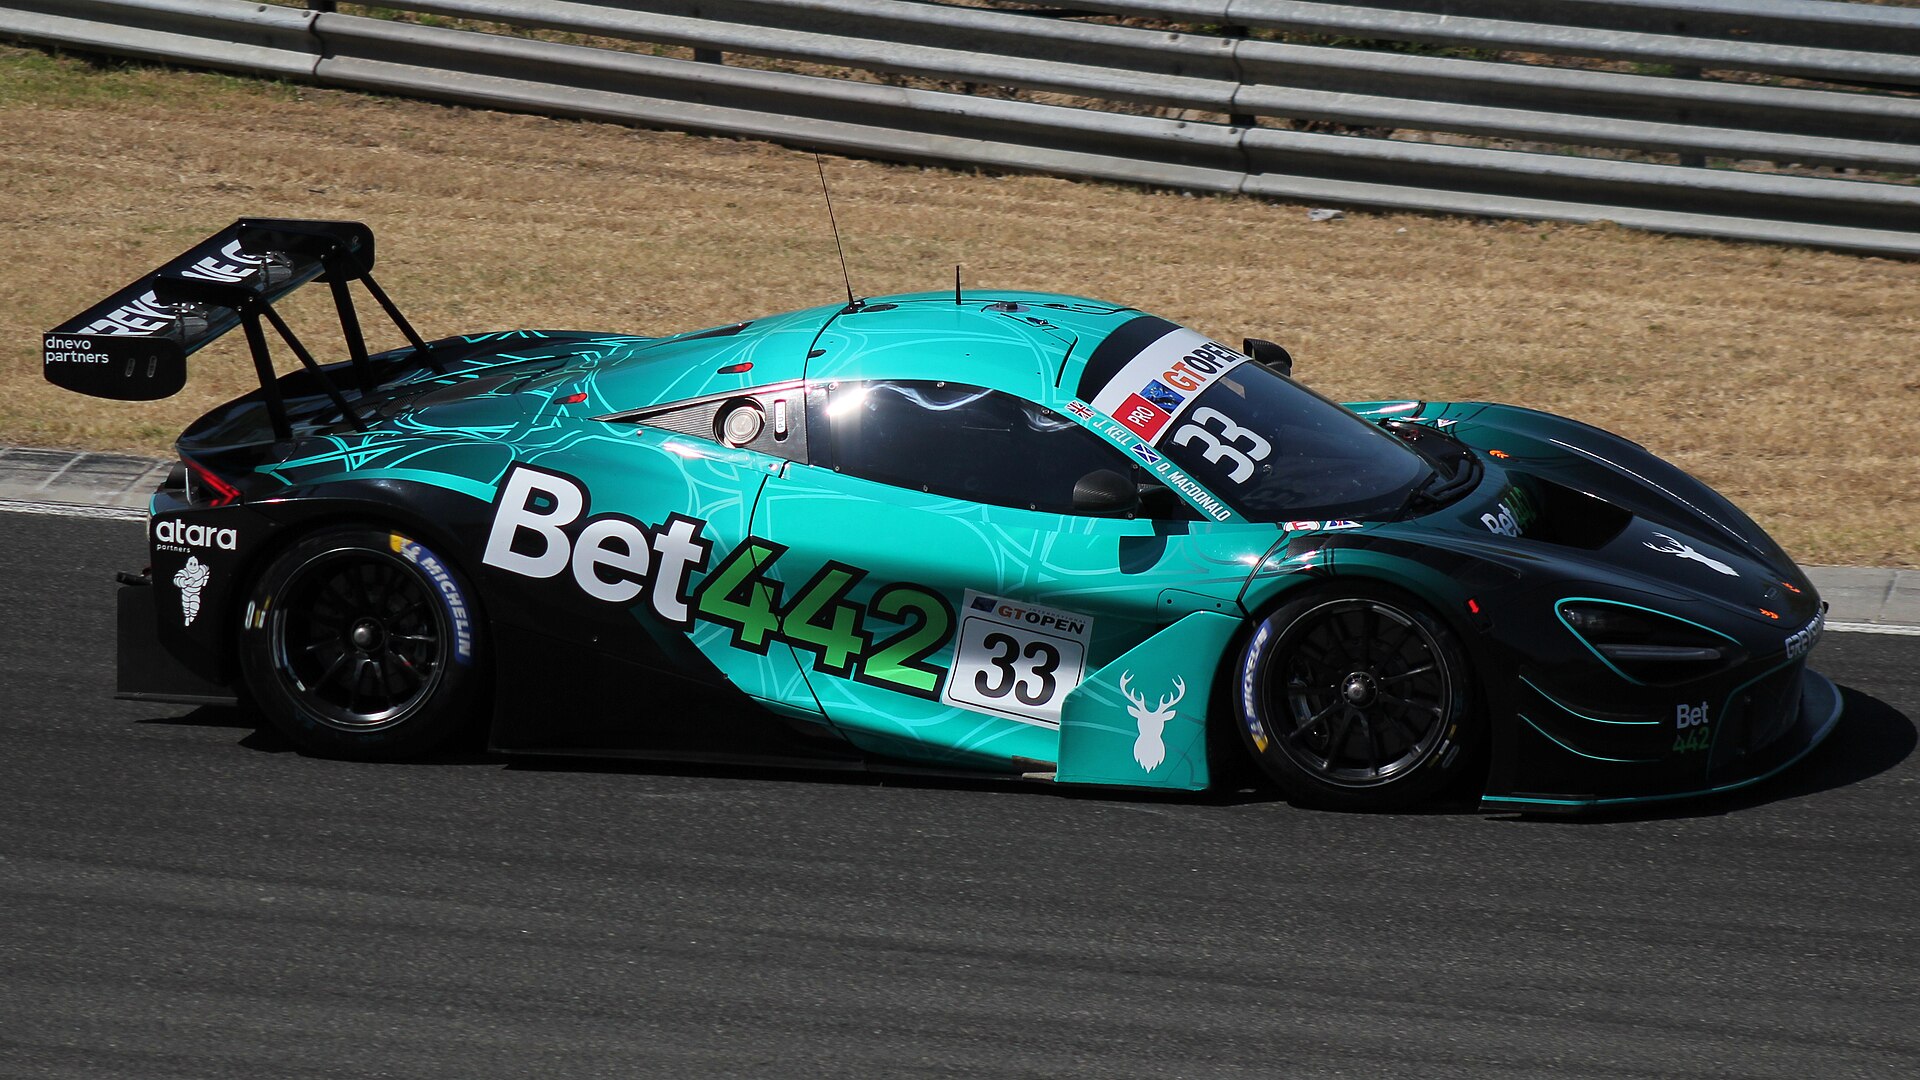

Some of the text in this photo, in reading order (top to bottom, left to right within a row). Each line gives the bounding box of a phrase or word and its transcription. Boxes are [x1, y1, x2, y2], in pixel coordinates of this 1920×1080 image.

[45, 336, 91, 350] dnevo
[46, 350, 109, 364] partners
[1127, 406, 1155, 427] PRO
[1093, 419, 1132, 446] J. KELL
[1173, 406, 1272, 484] 33
[1155, 462, 1232, 522] D. MACDONALD
[156, 519, 237, 550] atara
[156, 544, 191, 553] partners
[482, 466, 950, 692] Bet442
[418, 556, 472, 657] MICHELIN
[974, 633, 1060, 706] 33
[1676, 701, 1709, 729] Bet
[1672, 727, 1710, 753] 442
